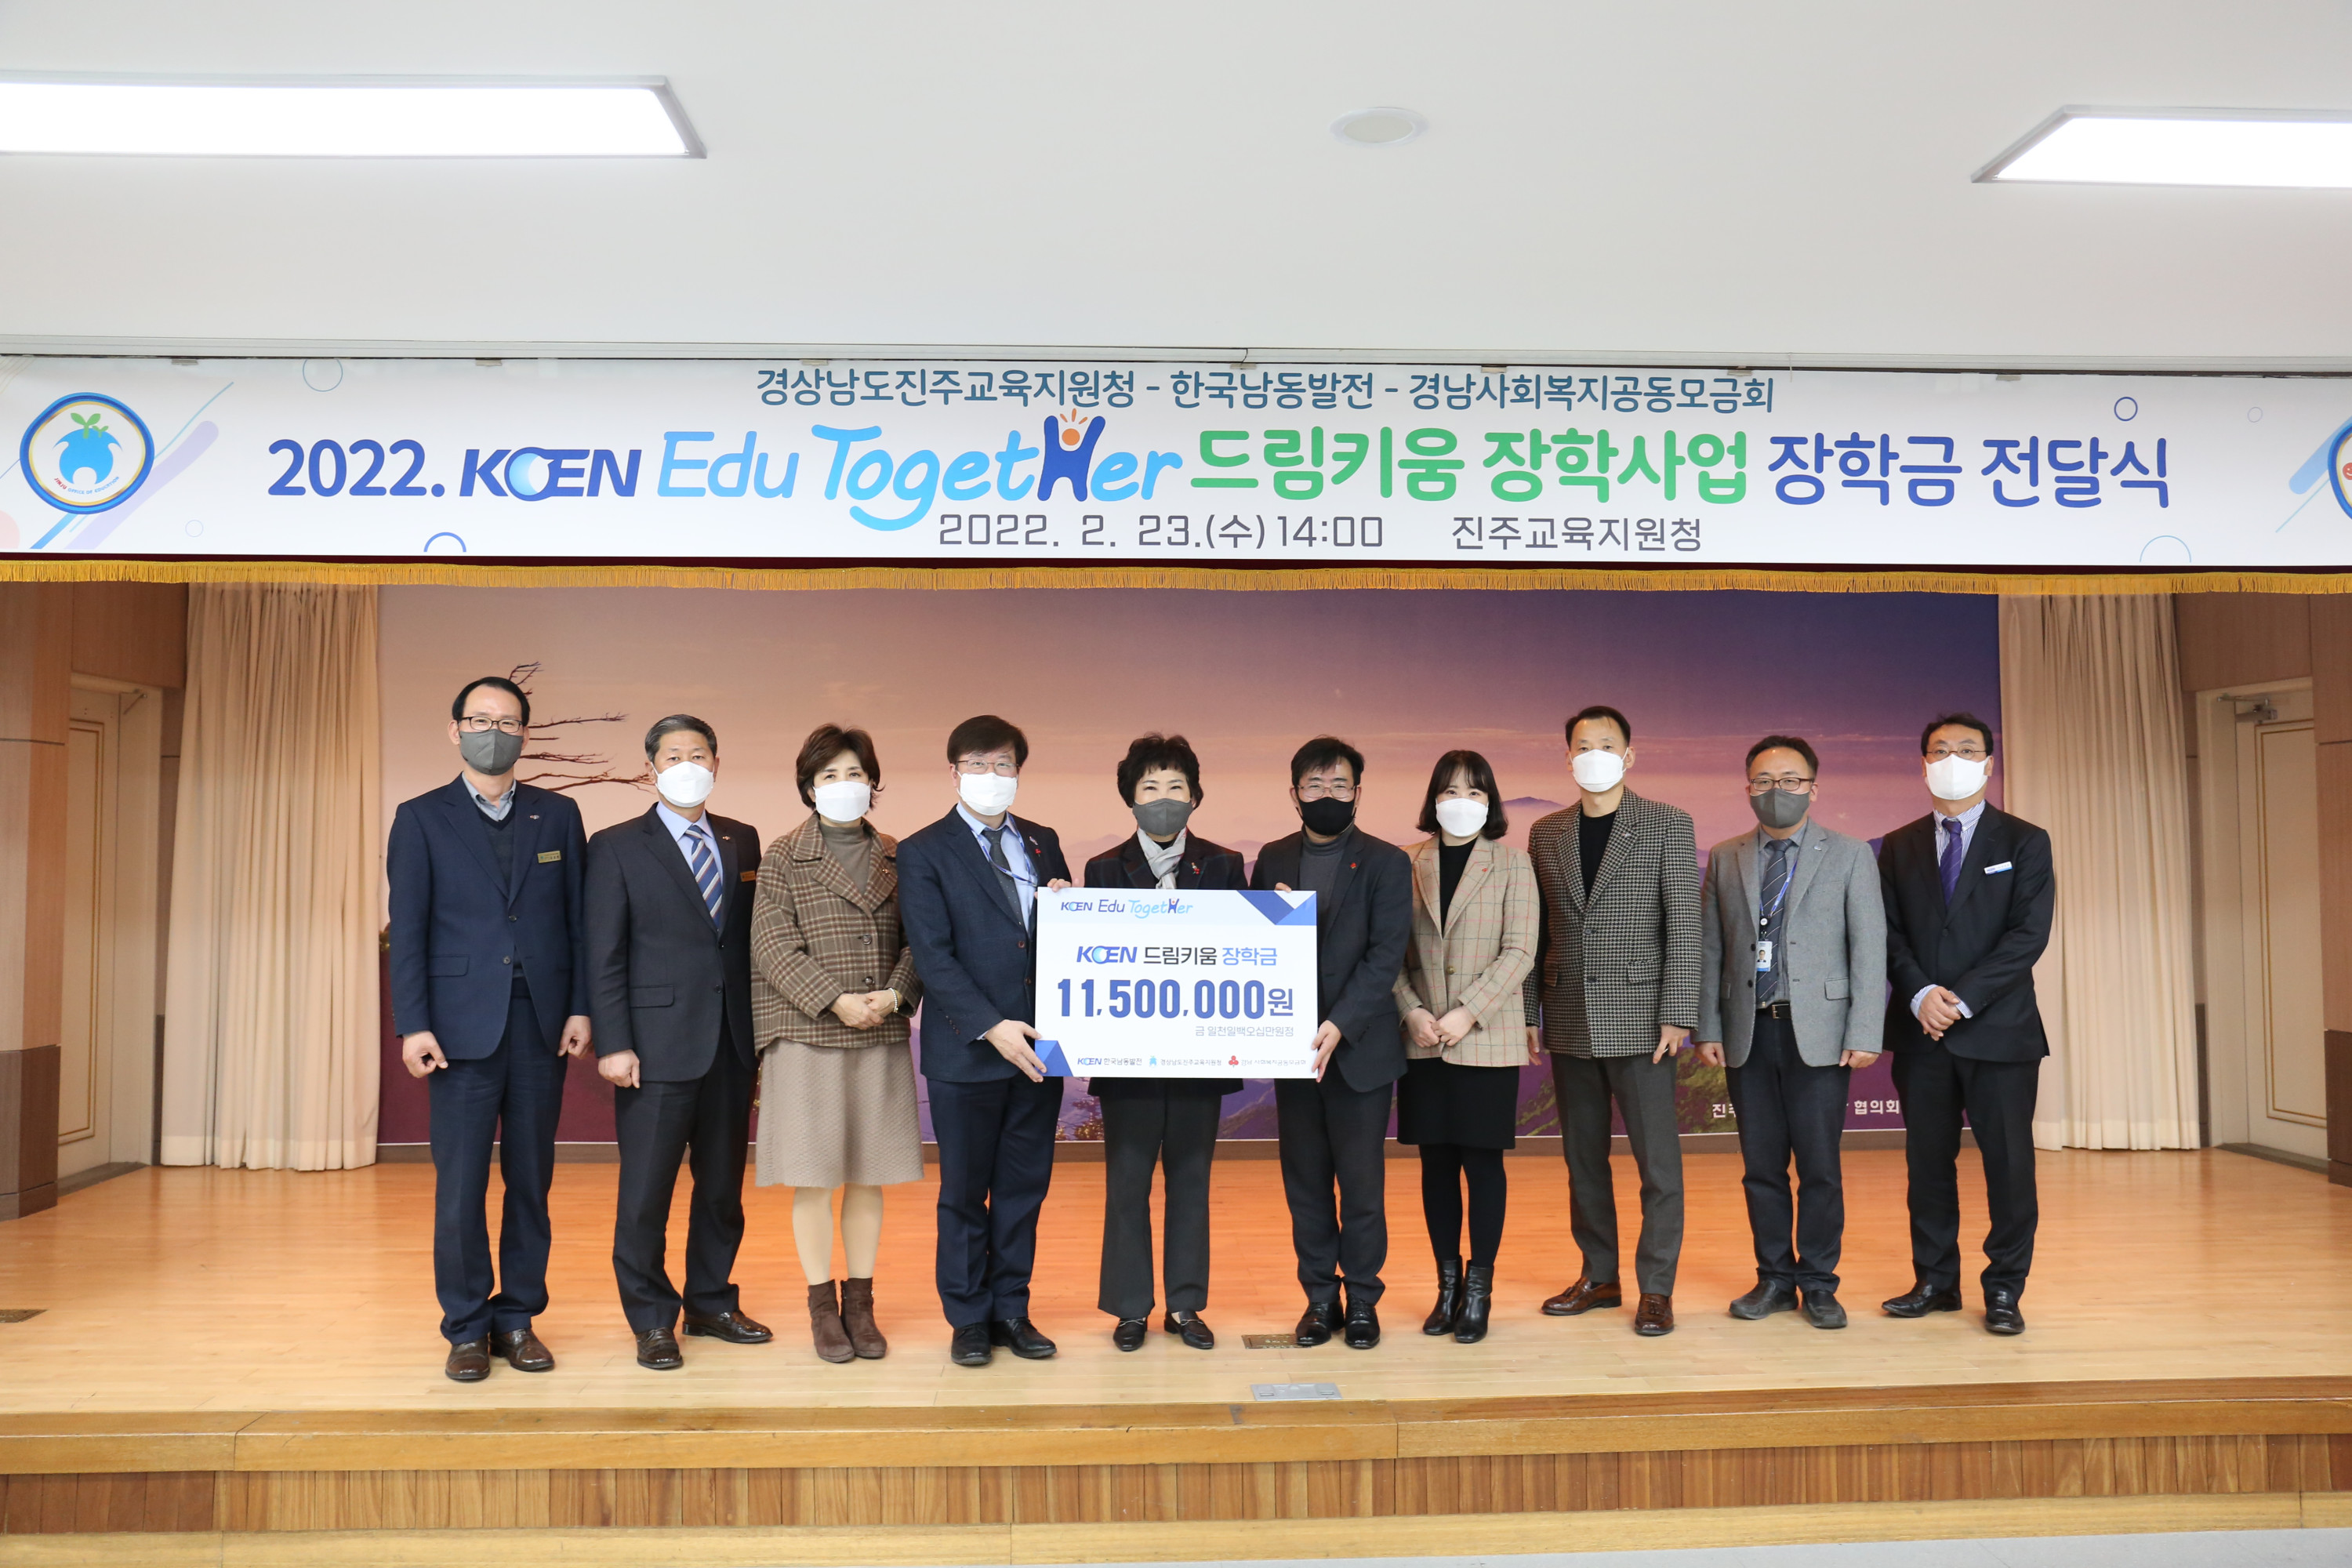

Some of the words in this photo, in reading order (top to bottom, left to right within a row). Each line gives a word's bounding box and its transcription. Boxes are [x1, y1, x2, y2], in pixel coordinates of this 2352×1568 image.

[757, 368, 1134, 408] 경상남도진주교육지원청
[1170, 370, 1374, 410] 한국남동발전
[1409, 372, 1774, 414] 경남사회복지공동모금회
[267, 438, 445, 498] 2022.
[459, 446, 642, 502] KOEN
[657, 430, 800, 499] Edu
[1190, 426, 1465, 502] 드림키움
[1483, 427, 1747, 505] 장학사업
[1767, 431, 1963, 507] 장학금
[1980, 435, 2169, 509] 전달식
[939, 514, 1059, 547] 2022.
[1082, 514, 1116, 547] 2.
[1452, 516, 1701, 552] 진주교육지원청
[1060, 901, 1094, 913] KOEN
[1098, 899, 1125, 913] Edu
[1076, 945, 1138, 965] KOEN
[1142, 946, 1218, 966] 드림키움
[1222, 947, 1278, 967] 장학금
[1057, 978, 1294, 1020] 11,500,000원
[1195, 1025, 1205, 1036] 금
[1207, 1025, 1294, 1037] 일천일백오십만원정
[1103, 1058, 1142, 1066] 한국남동발전
[1853, 1099, 1900, 1115] 협의회
